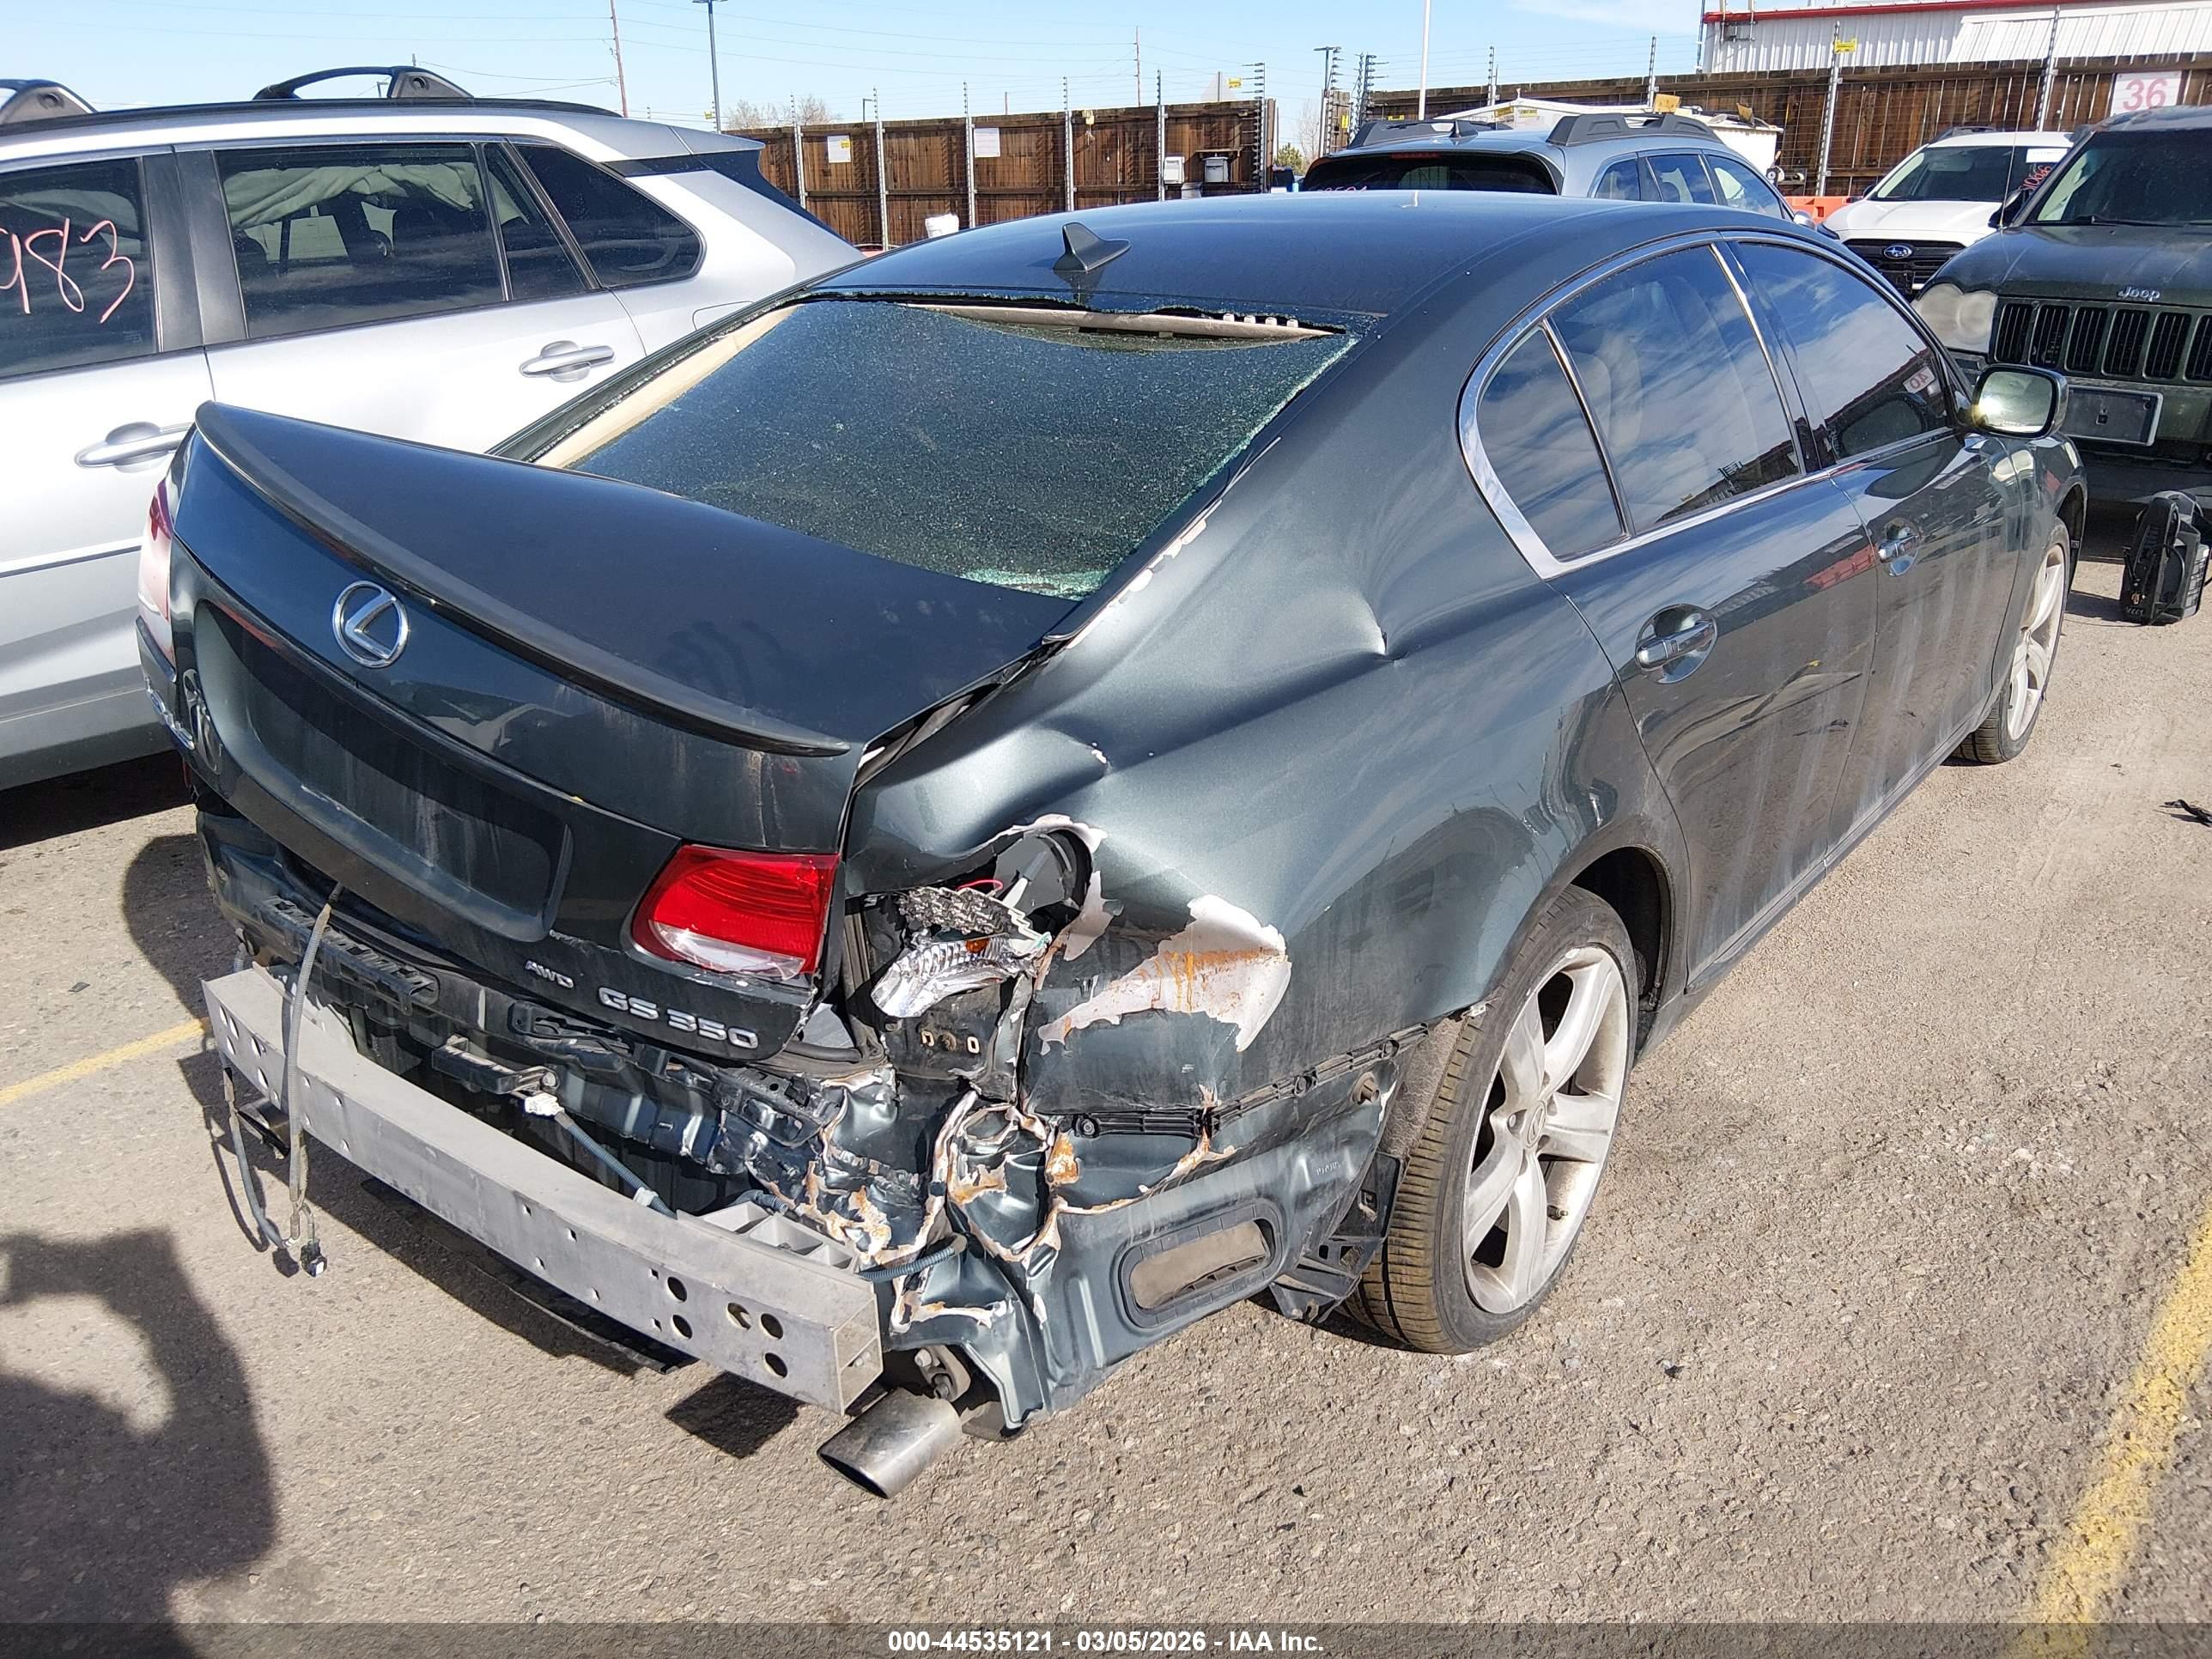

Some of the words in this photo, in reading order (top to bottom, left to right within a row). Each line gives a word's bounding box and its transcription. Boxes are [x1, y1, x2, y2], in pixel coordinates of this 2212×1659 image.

[2123, 77, 2168, 111] 36
[2117, 286, 2160, 302] Jeep
[525, 960, 574, 988] AWD
[599, 987, 659, 1020] GS
[666, 1008, 759, 1049] 350
